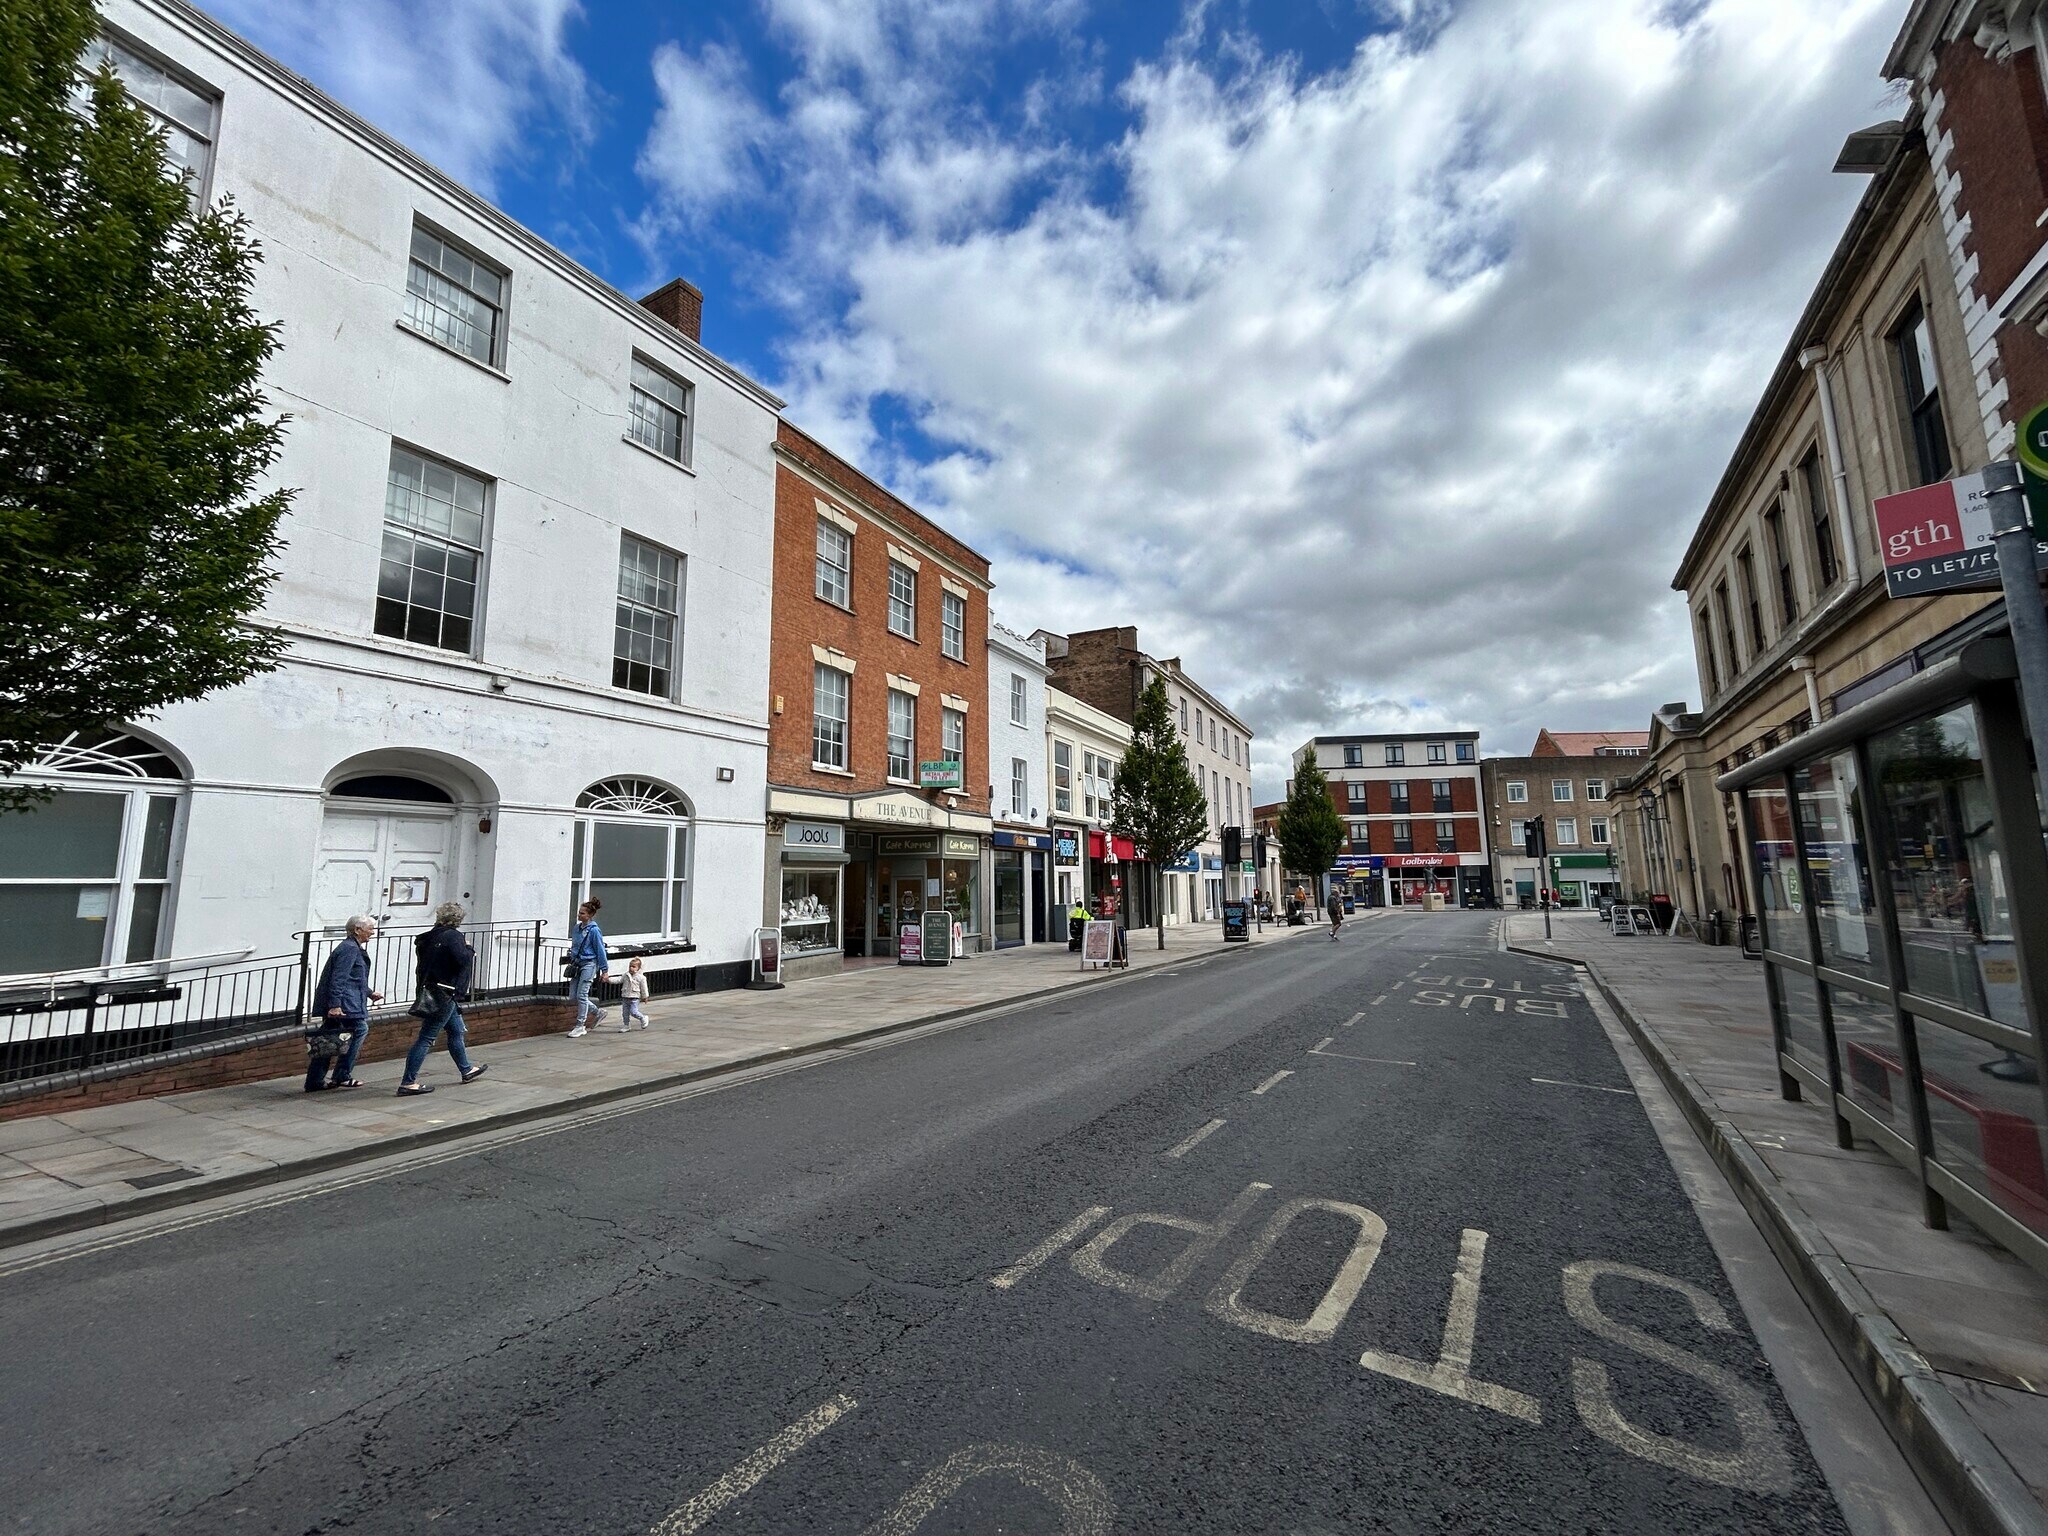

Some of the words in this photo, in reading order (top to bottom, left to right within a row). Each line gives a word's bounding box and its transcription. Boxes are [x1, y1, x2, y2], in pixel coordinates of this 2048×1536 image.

[1887, 519, 1954, 558] gth
[1893, 567, 1922, 582] TO
[1931, 552, 1999, 575] LET/F
[929, 762, 943, 770] LBP
[877, 803, 896, 816] THE
[899, 805, 932, 820] AVENUE
[1412, 975, 1580, 997] STOP
[1408, 990, 1569, 1019] BUS
[1068, 1180, 1796, 1496] STOP
